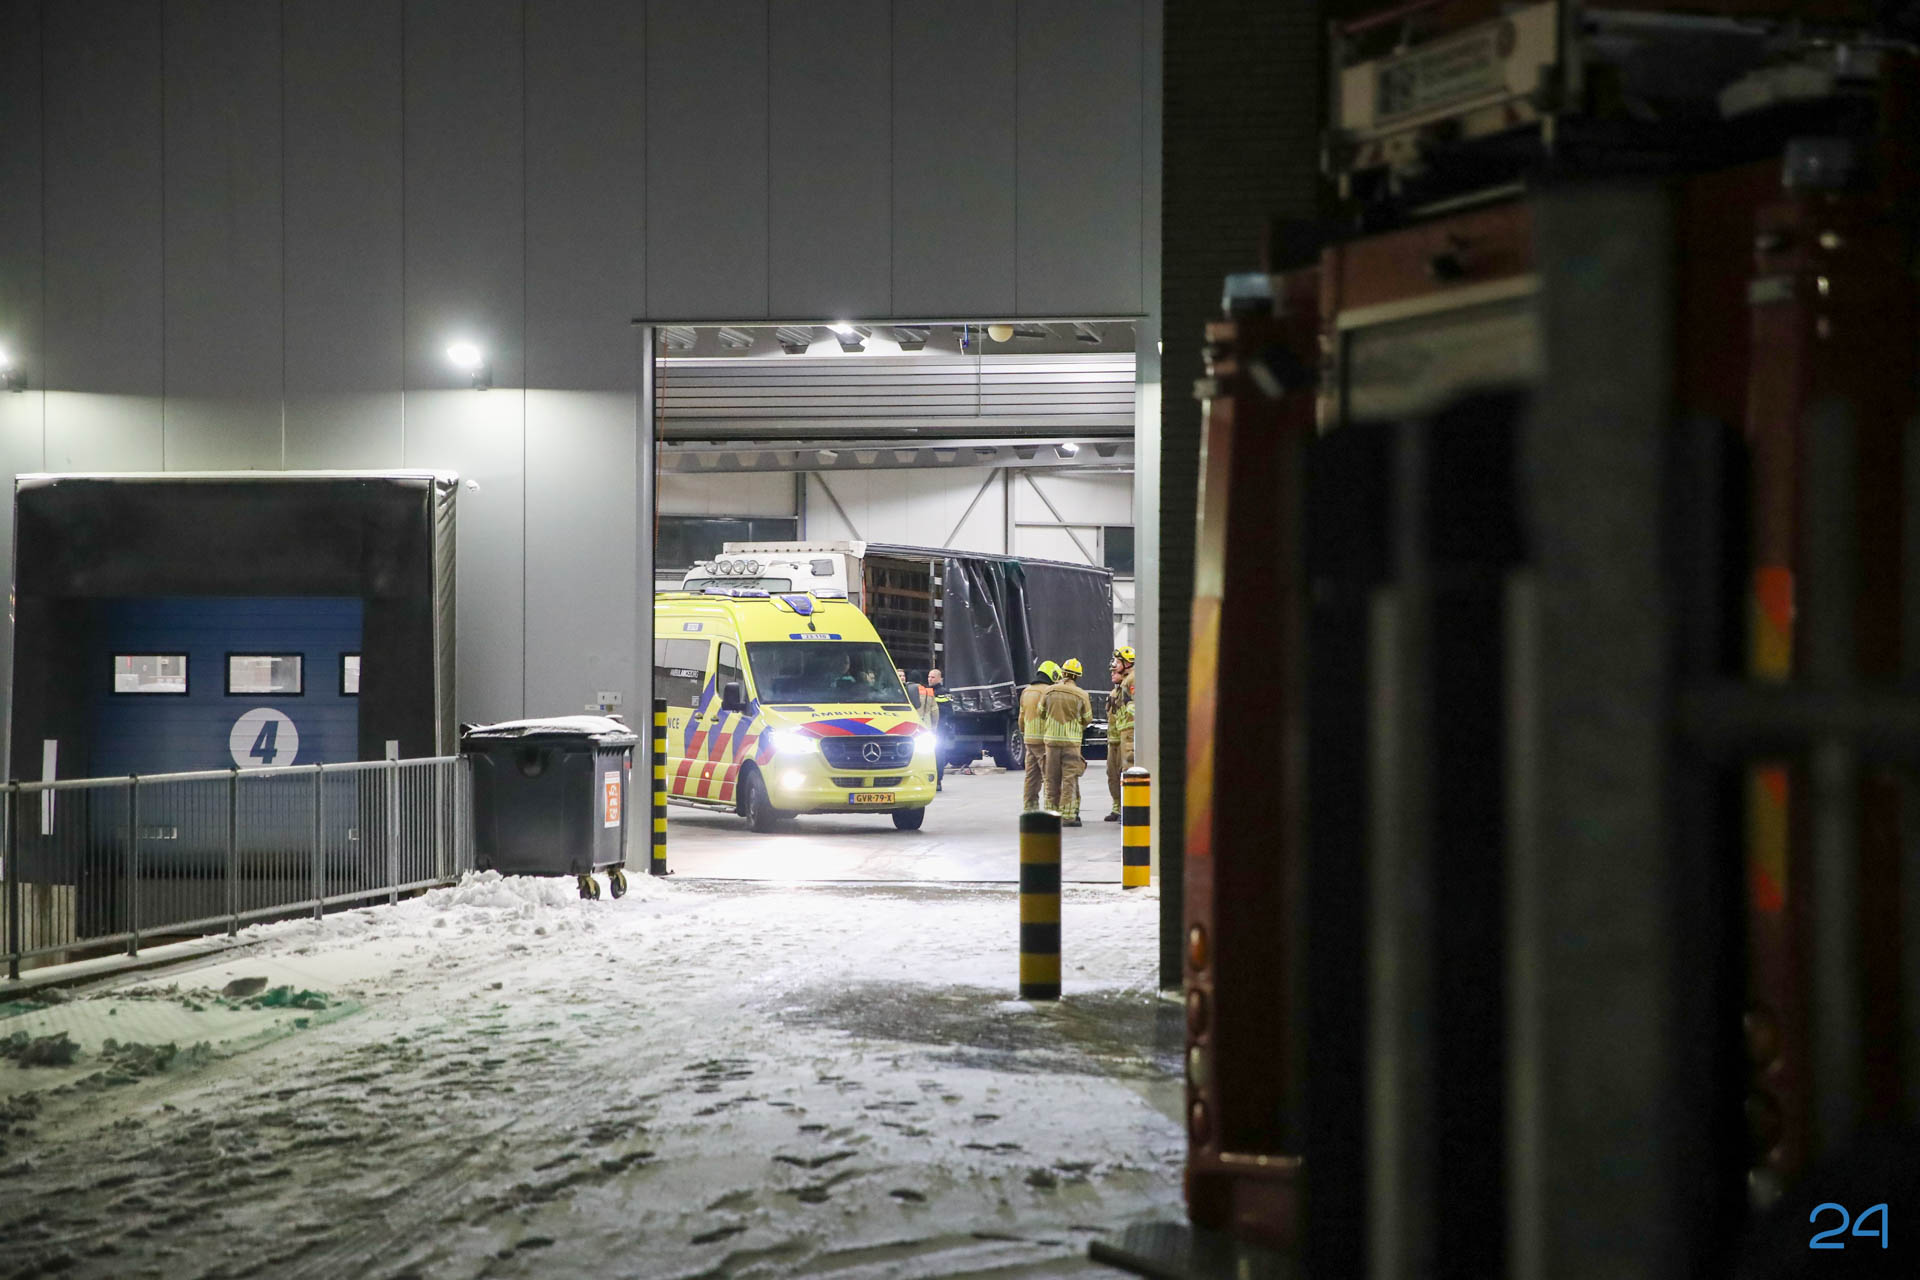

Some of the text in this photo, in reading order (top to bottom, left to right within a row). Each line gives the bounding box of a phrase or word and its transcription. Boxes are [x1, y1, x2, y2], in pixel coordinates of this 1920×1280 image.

[811, 710, 900, 719] AMBULANCE
[249, 720, 279, 764] 4
[856, 794, 892, 803] GVR-79-X
